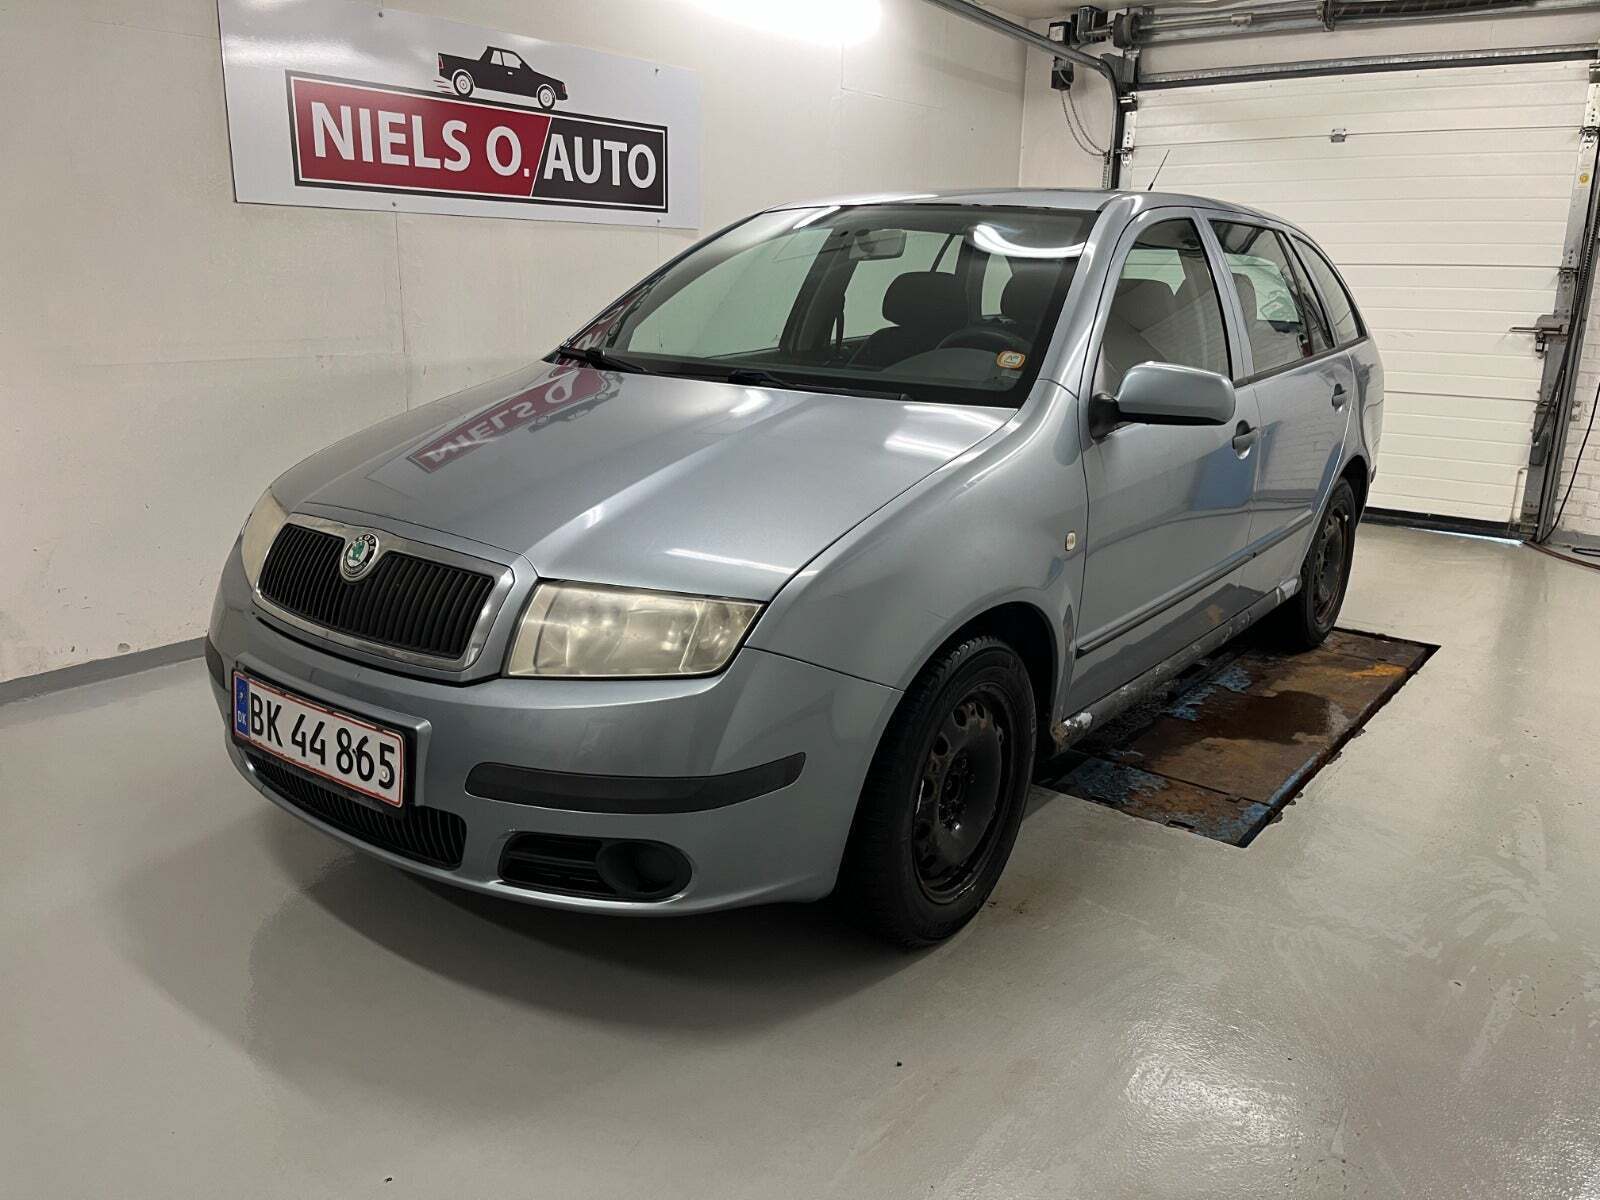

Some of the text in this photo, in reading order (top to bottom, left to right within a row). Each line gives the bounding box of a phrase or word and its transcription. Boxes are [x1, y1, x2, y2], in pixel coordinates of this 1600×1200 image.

[310, 102, 656, 189] NIELS O. AUTO
[250, 692, 395, 790] BK 44 865
